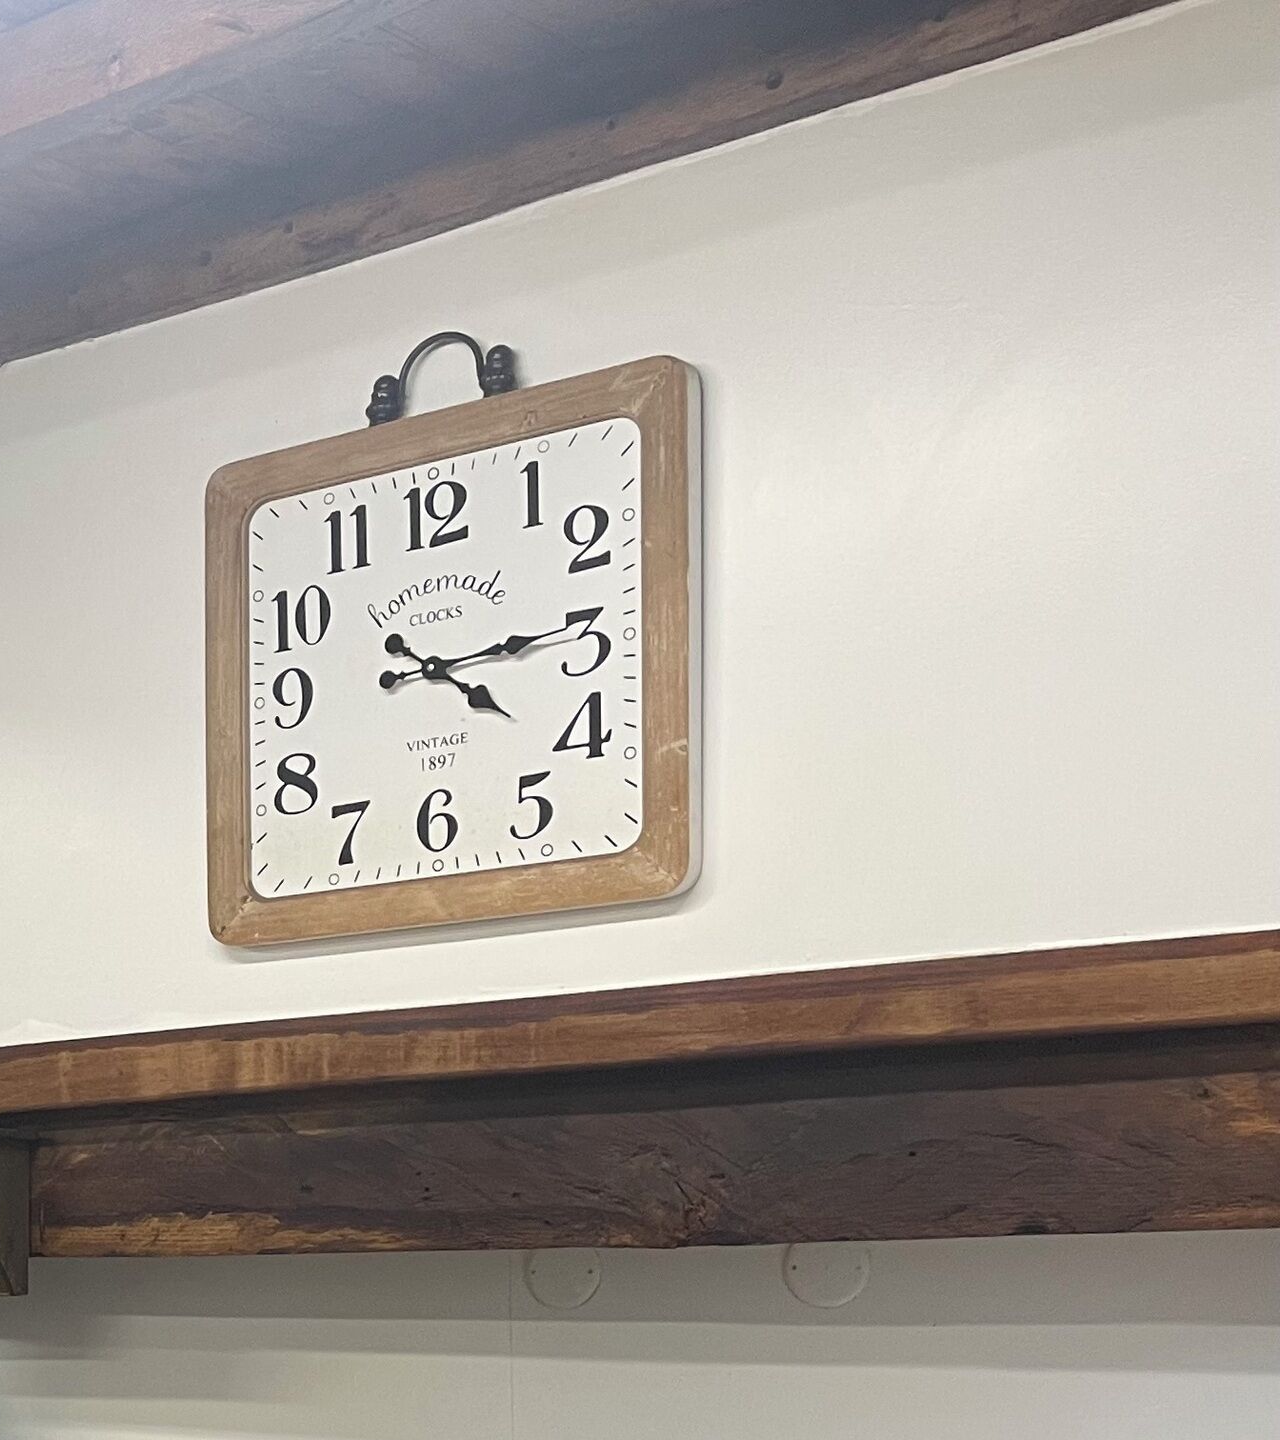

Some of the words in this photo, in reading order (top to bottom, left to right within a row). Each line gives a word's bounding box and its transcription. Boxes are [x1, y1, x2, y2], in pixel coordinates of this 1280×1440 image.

[402, 480, 470, 553] 12
[519, 460, 545, 530] 1
[324, 504, 372, 576] 11
[563, 504, 612, 575] 2
[271, 584, 332, 654] 10
[366, 569, 507, 629] homemade
[408, 604, 464, 628] CLOCKS
[560, 605, 612, 678] 3
[271, 667, 314, 730] 9
[551, 690, 613, 760] 4
[405, 731, 470, 753] VINTAGE
[420, 752, 457, 773] 1897
[273, 752, 319, 816] 8
[509, 770, 554, 840] 5
[330, 799, 371, 867] 7
[416, 788, 459, 854] 6
